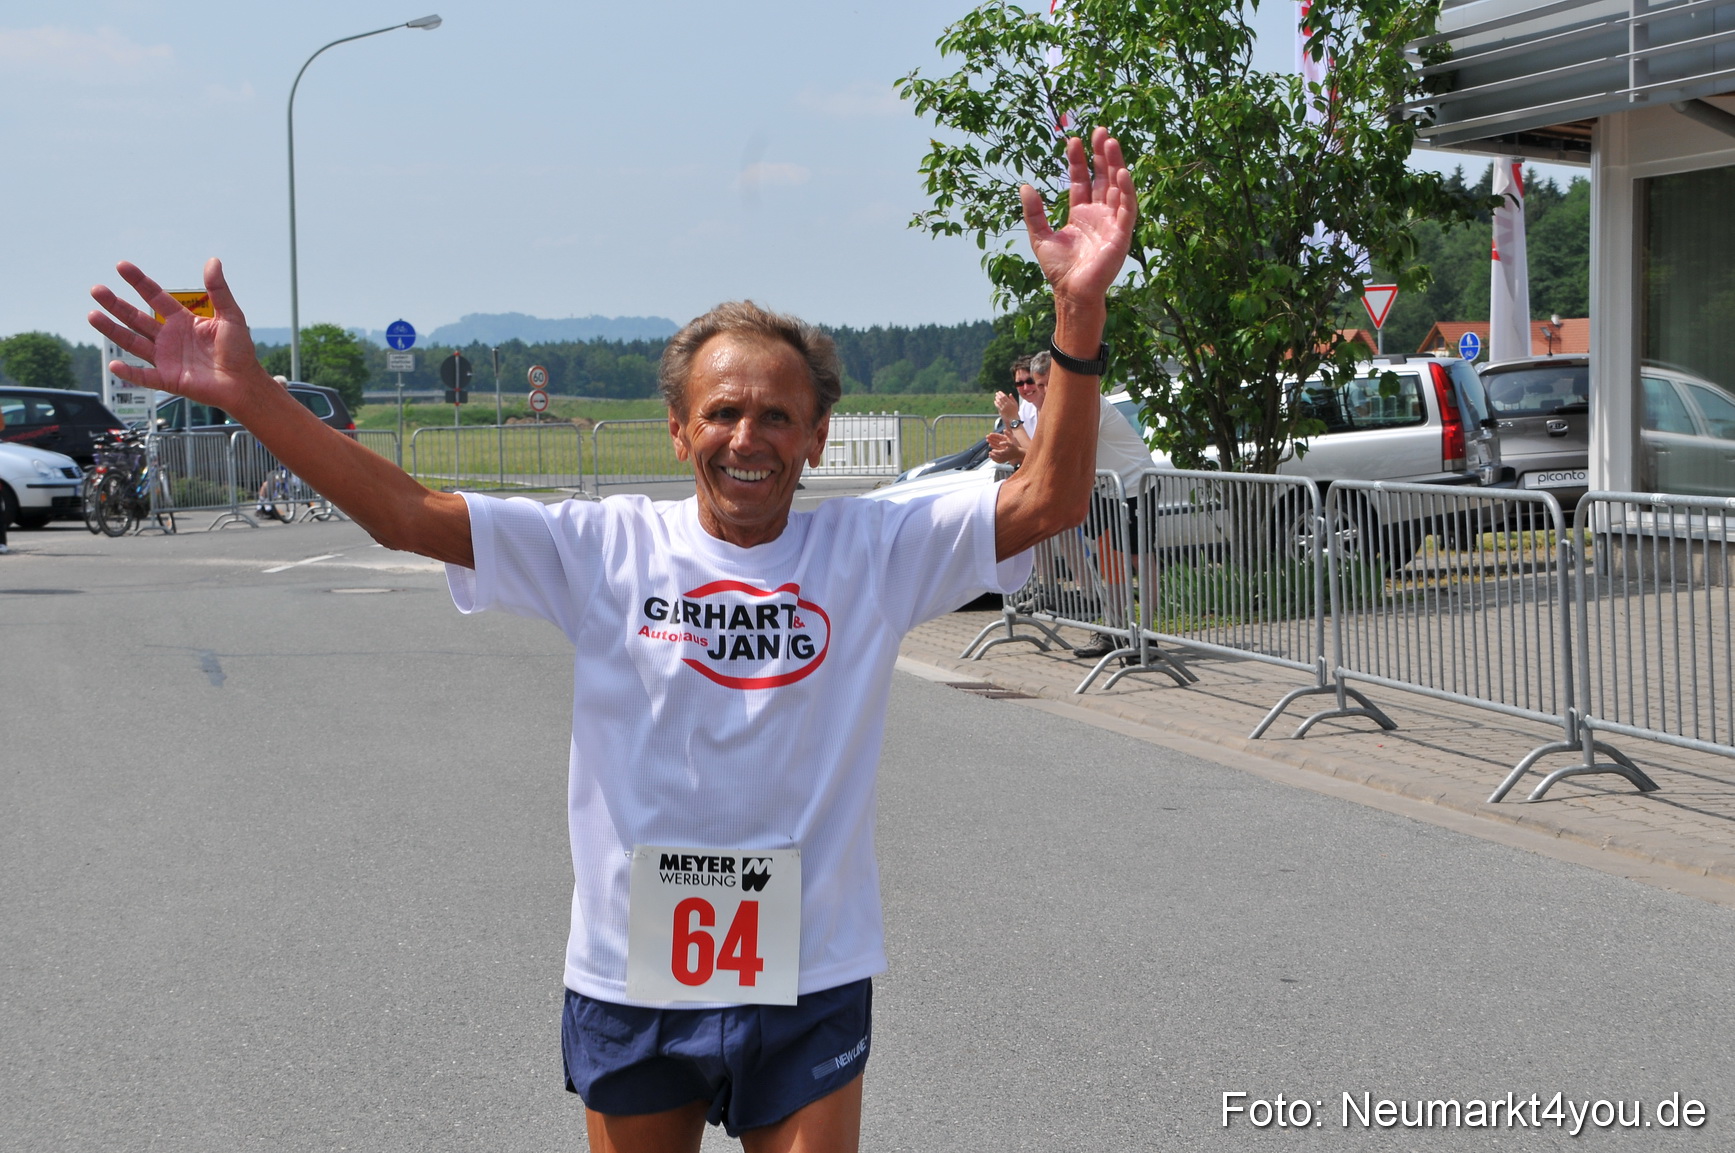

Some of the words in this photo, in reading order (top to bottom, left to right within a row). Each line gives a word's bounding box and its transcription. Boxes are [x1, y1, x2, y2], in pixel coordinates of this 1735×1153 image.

[533, 372, 544, 383] 60
[1538, 470, 1586, 485] picanto
[793, 615, 806, 629] &
[659, 853, 736, 873] MEYER
[659, 872, 737, 887] WERBUNG
[671, 897, 764, 987] 64
